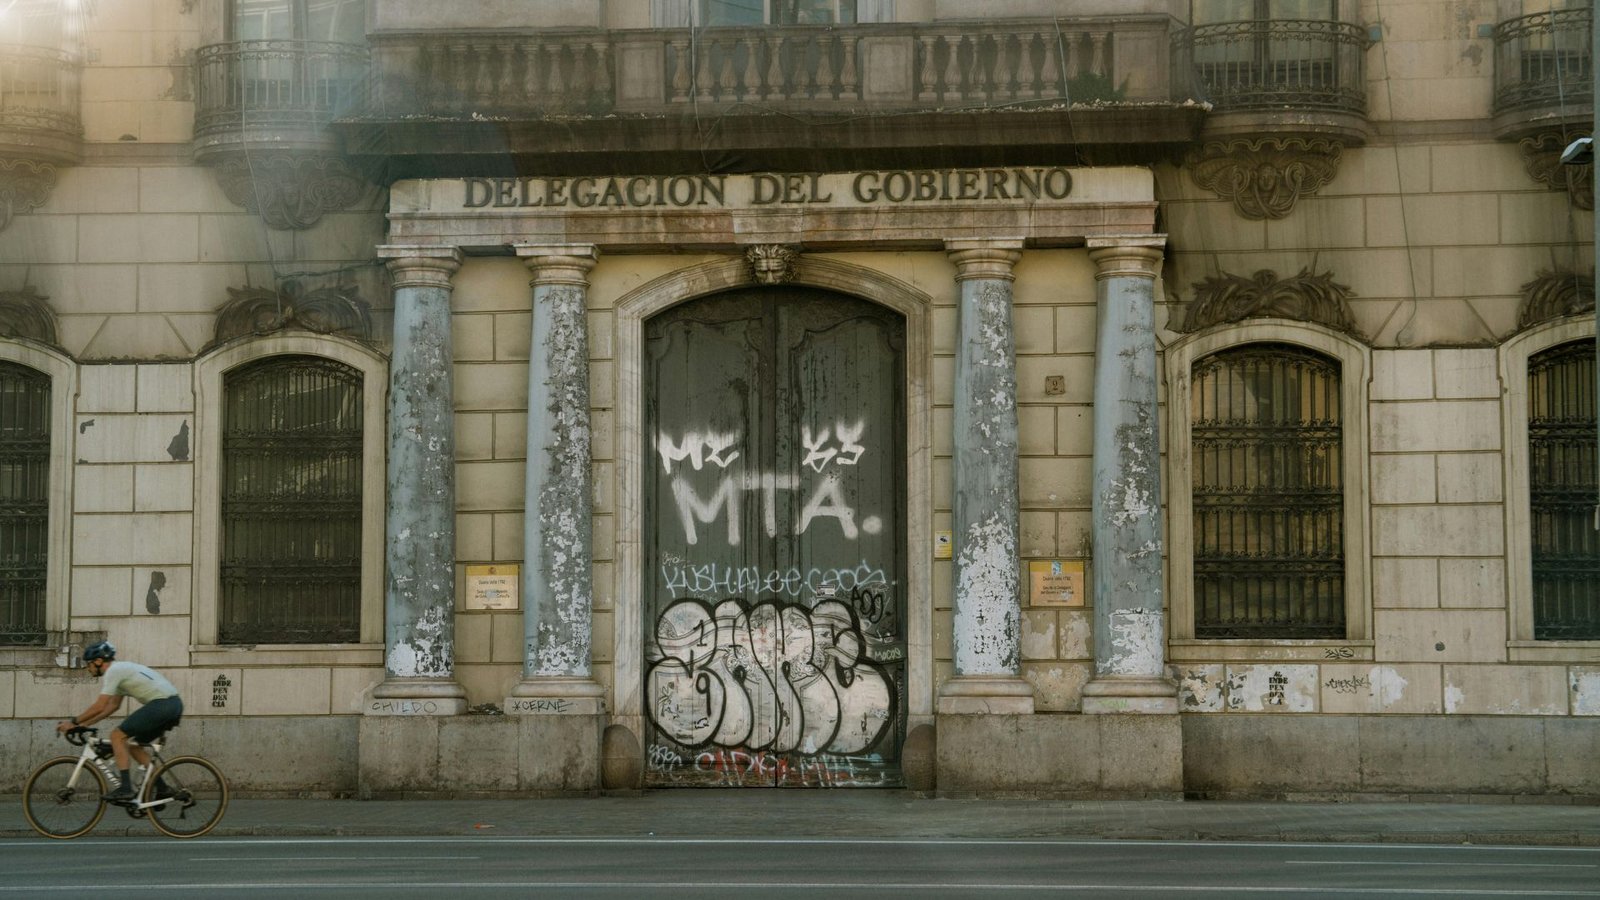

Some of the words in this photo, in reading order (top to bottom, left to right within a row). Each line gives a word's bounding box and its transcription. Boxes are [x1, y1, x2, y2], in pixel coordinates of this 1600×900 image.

[463, 175, 727, 207] DELEGACION
[751, 172, 832, 204] DEL
[853, 168, 1073, 202] GOBIERNO
